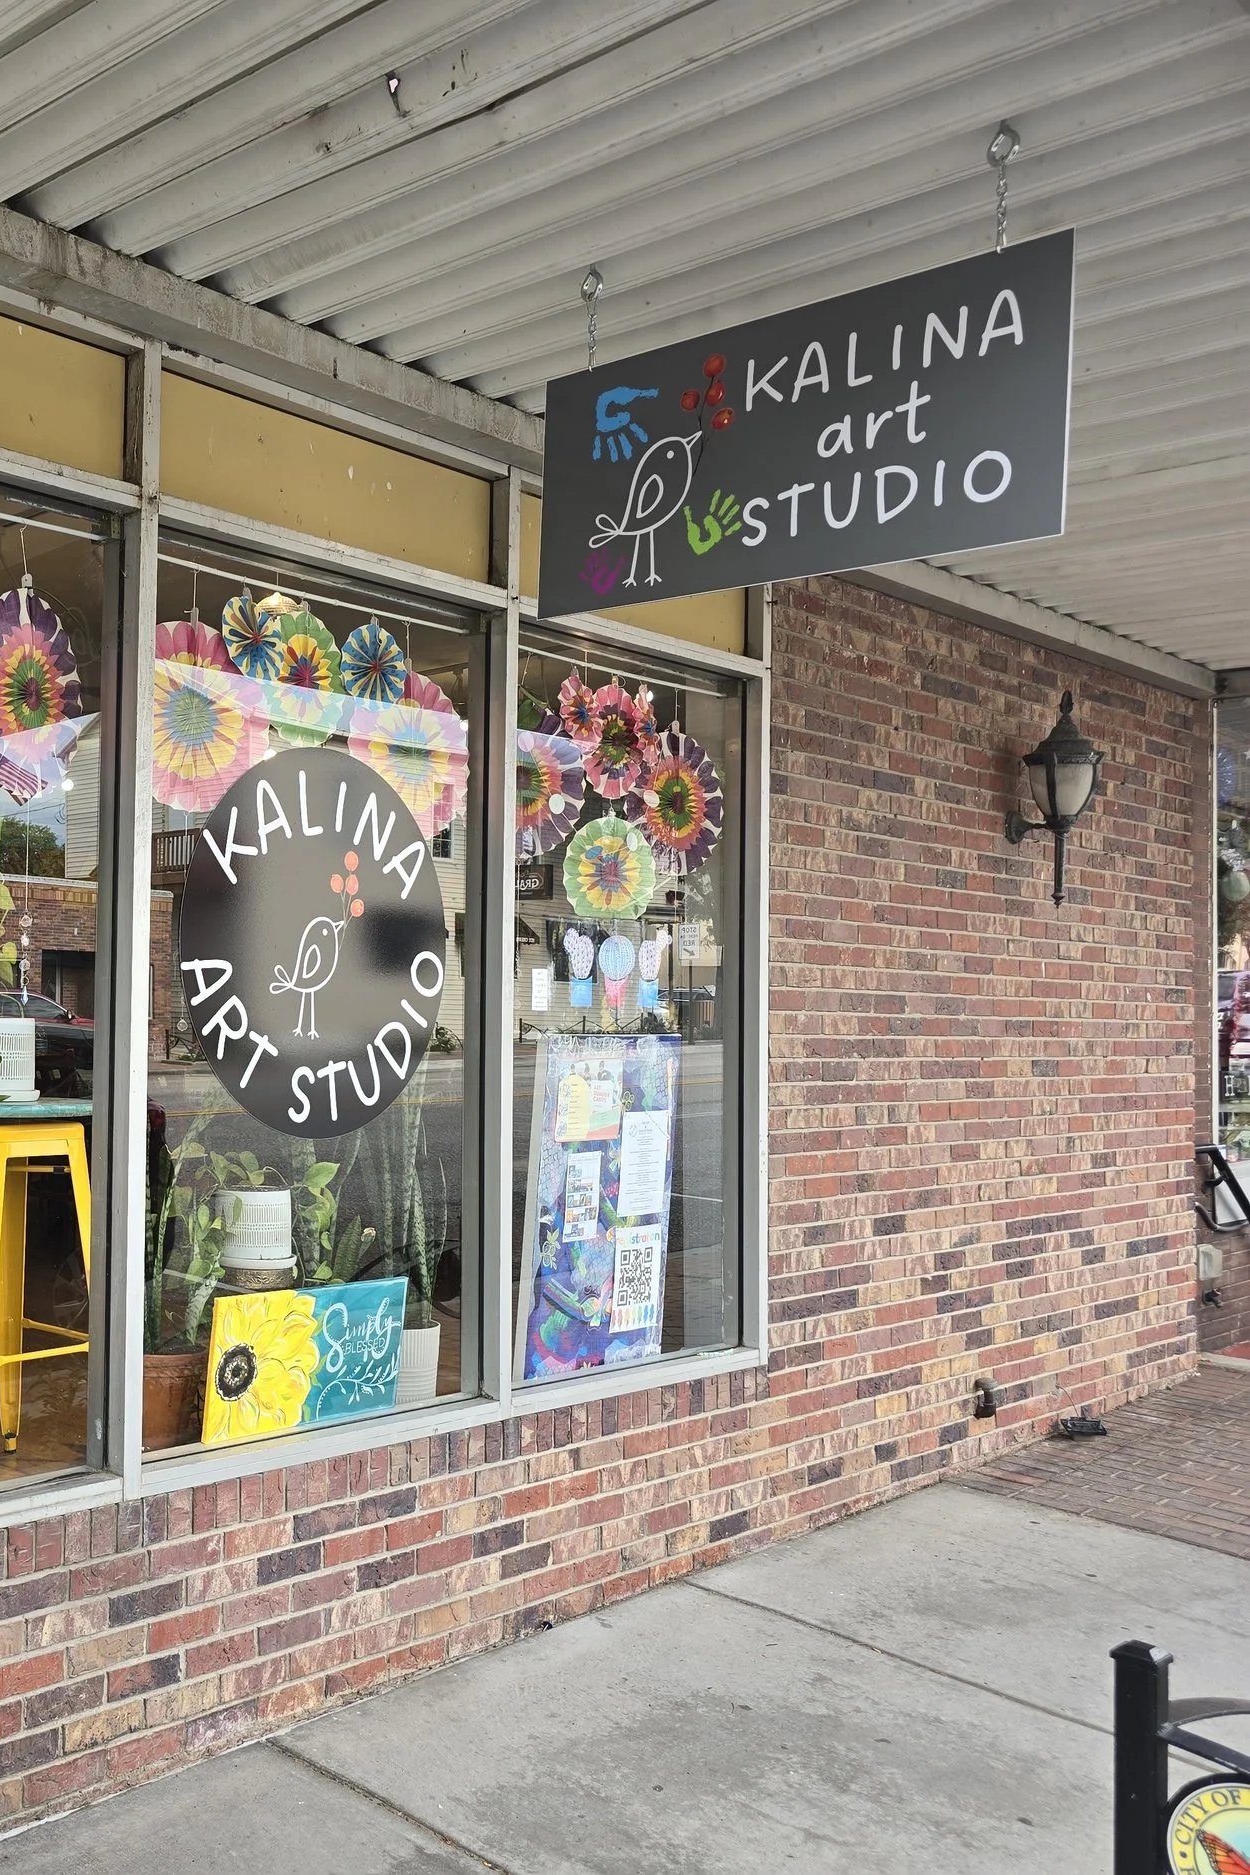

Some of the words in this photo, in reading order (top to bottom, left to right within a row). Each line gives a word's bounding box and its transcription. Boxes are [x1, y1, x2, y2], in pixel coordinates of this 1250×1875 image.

[745, 288, 1024, 412] KALINA
[816, 380, 931, 459] art
[741, 450, 1013, 547] STUDIO
[202, 770, 427, 900] KALINA
[180, 958, 279, 1089] ART
[288, 950, 444, 1124] STUDIO
[322, 1297, 402, 1373] Simply
[344, 1337, 386, 1355] BLESSED
[1175, 1797, 1210, 1845] CITY
[1211, 1788, 1242, 1807] OF
